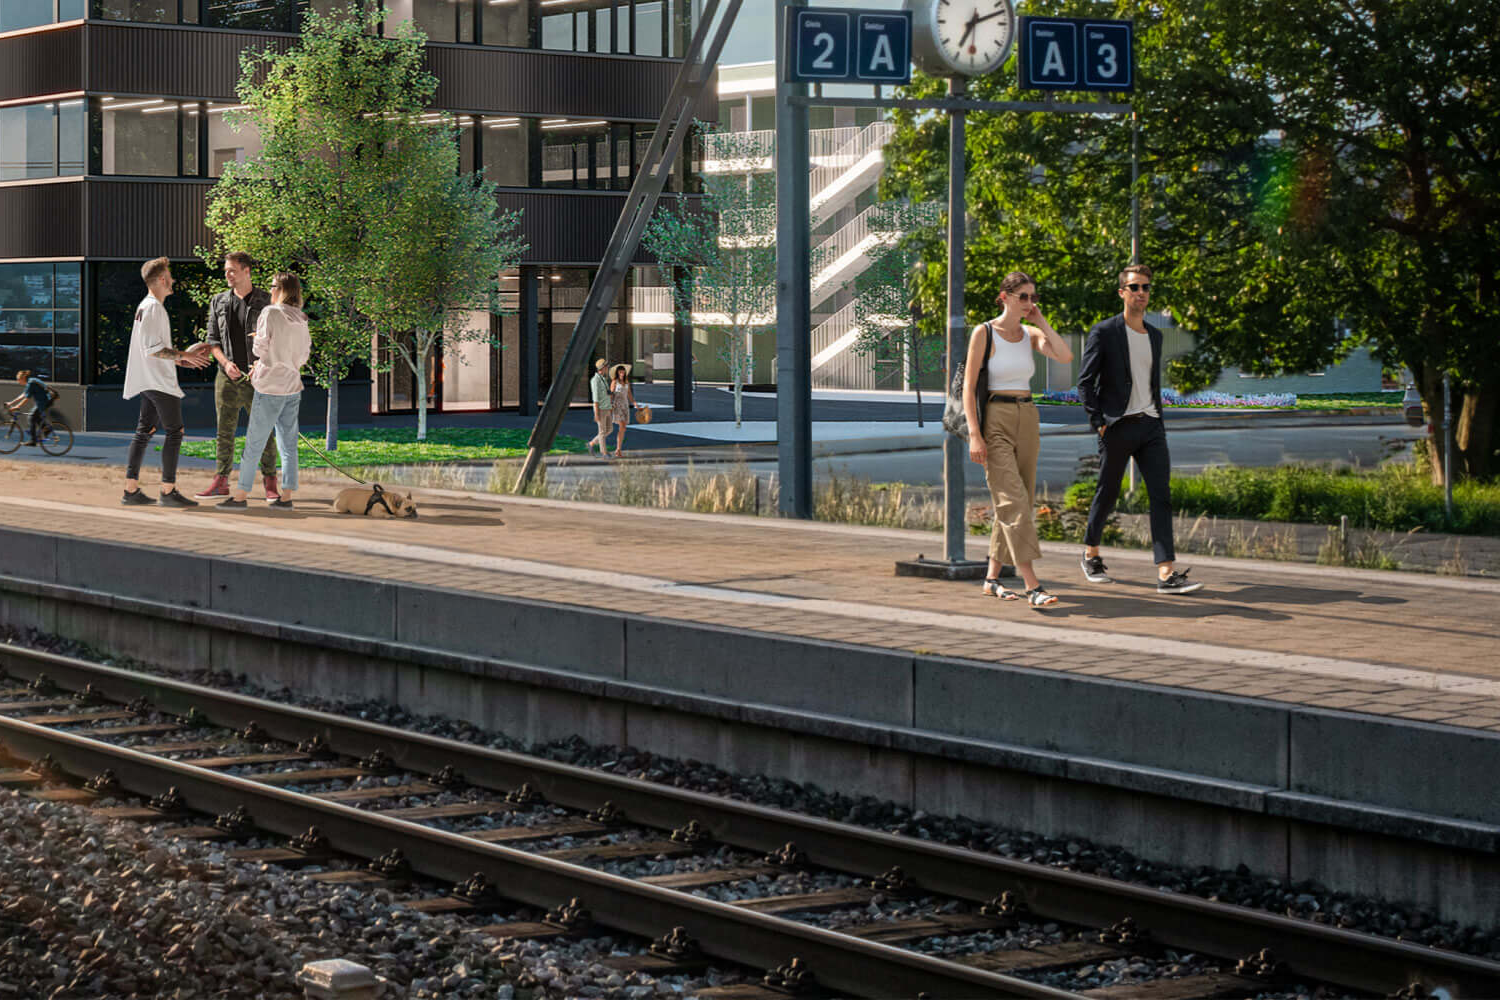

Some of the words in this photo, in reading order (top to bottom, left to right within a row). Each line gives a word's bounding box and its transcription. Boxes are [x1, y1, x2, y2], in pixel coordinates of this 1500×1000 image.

[812, 32, 835, 69] 2
[869, 34, 895, 71] A
[1041, 41, 1066, 77] A
[1097, 43, 1118, 78] 3
